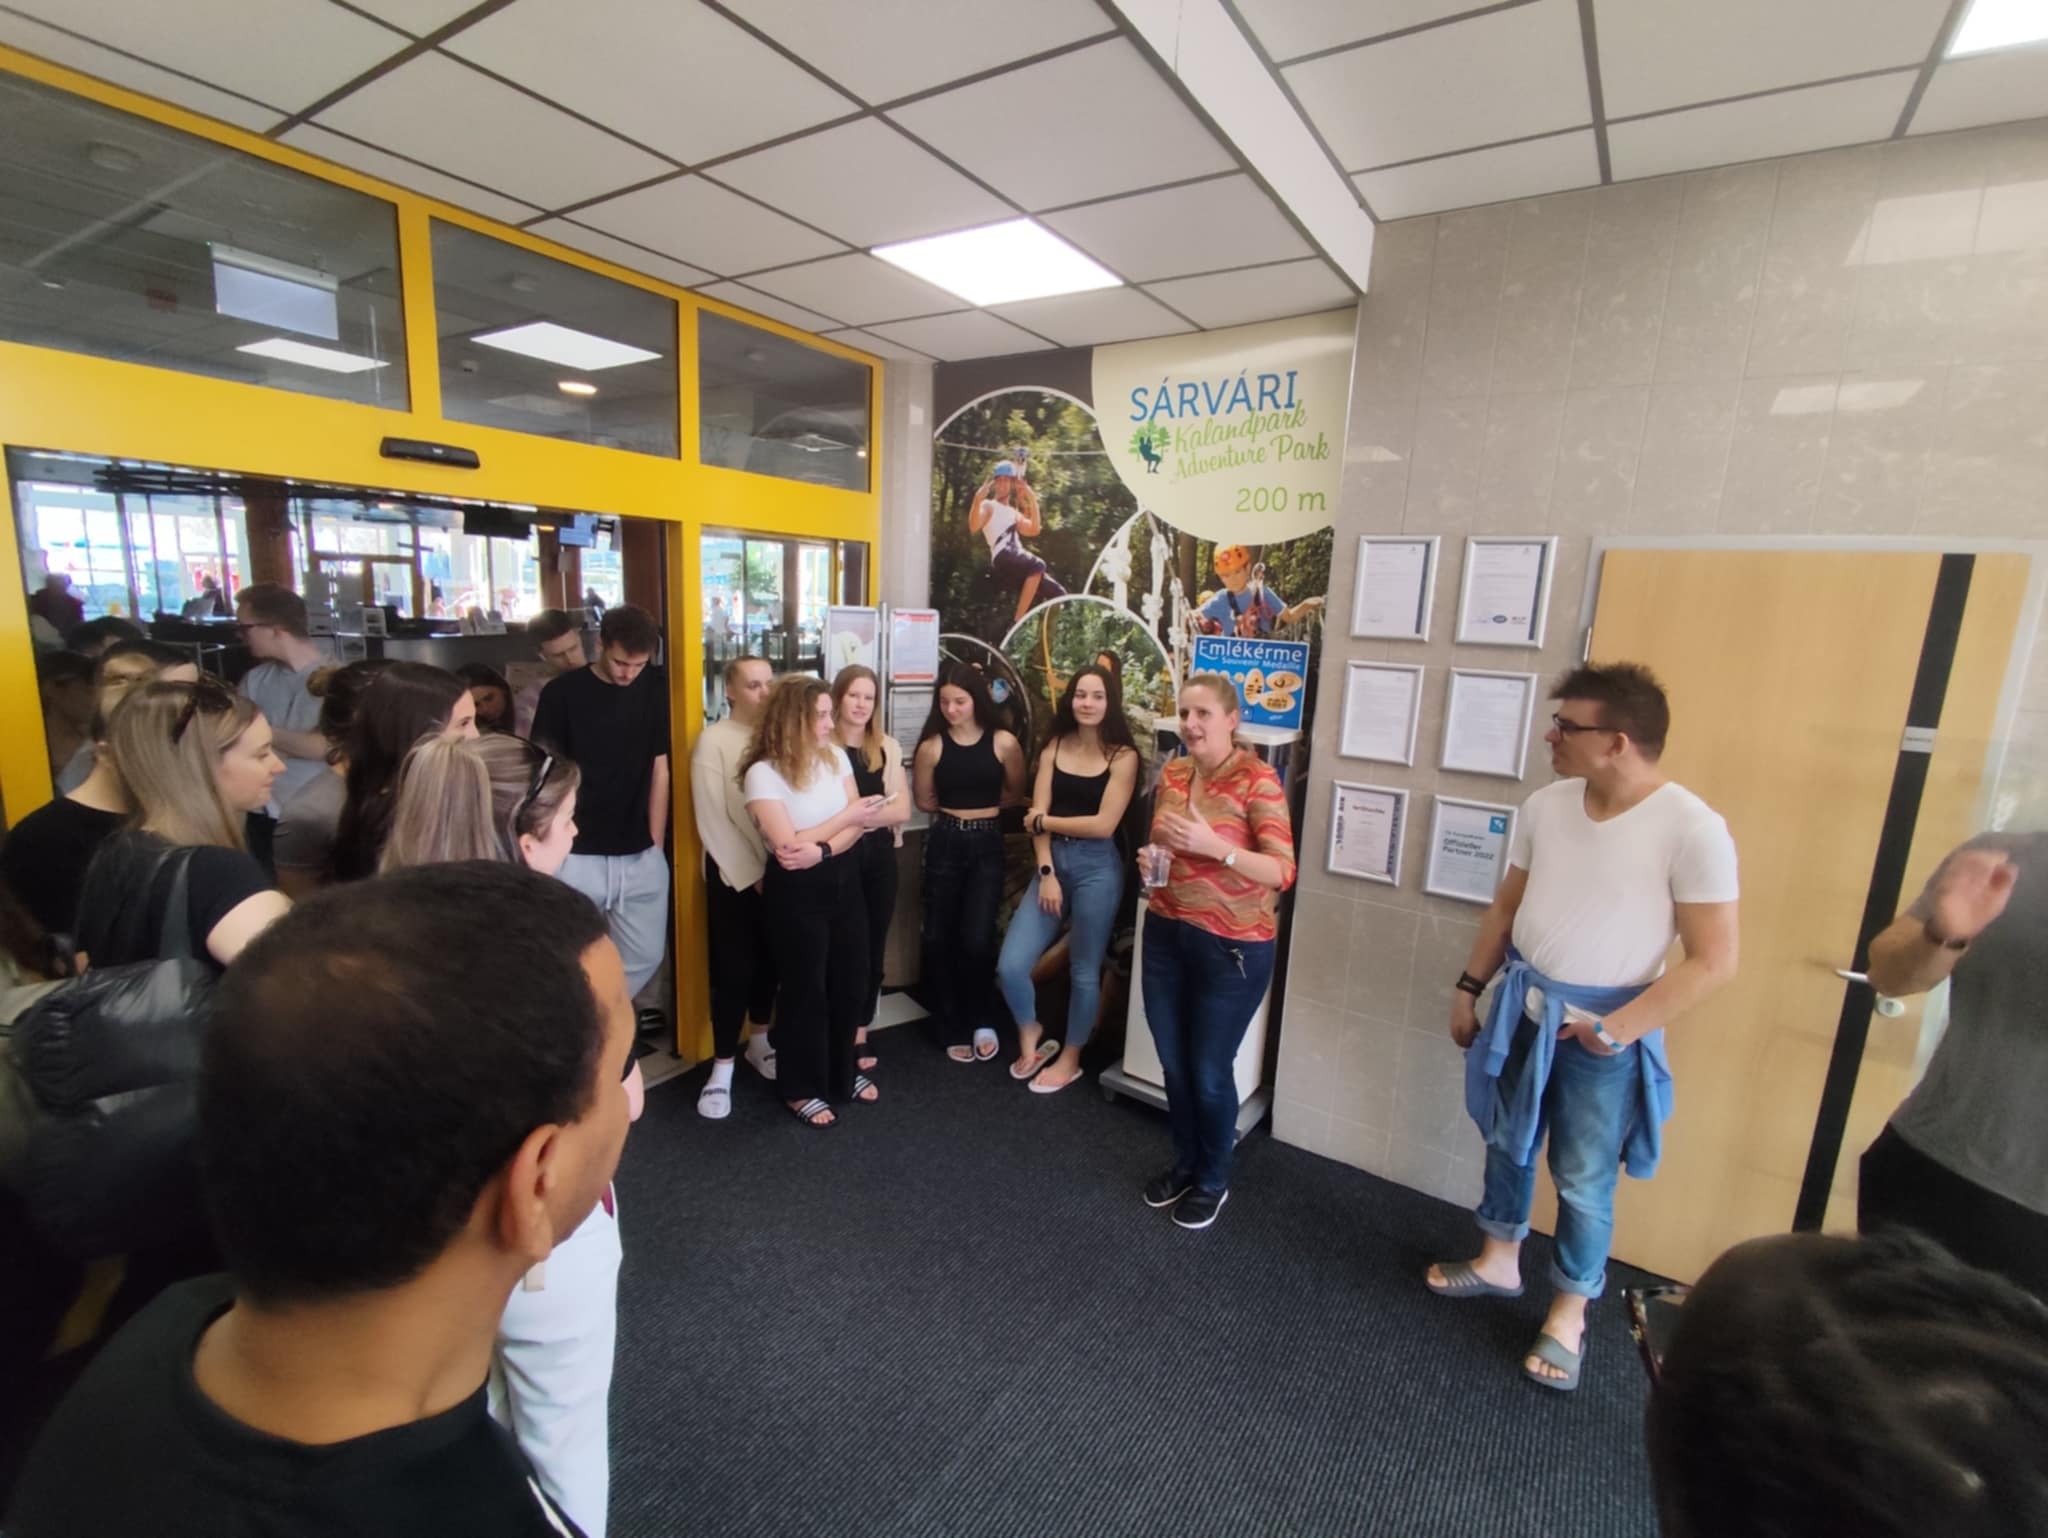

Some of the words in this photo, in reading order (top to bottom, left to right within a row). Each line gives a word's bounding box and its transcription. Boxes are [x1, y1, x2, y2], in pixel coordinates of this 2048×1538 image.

[1130, 369, 1298, 421] SÁRVÁRI
[1175, 399, 1307, 453] Kalandpark
[1174, 446, 1266, 480] Adventure
[1270, 432, 1329, 462] Park
[1235, 486, 1288, 513] 200
[1297, 490, 1327, 512] m
[1199, 639, 1303, 662] Emlékérme
